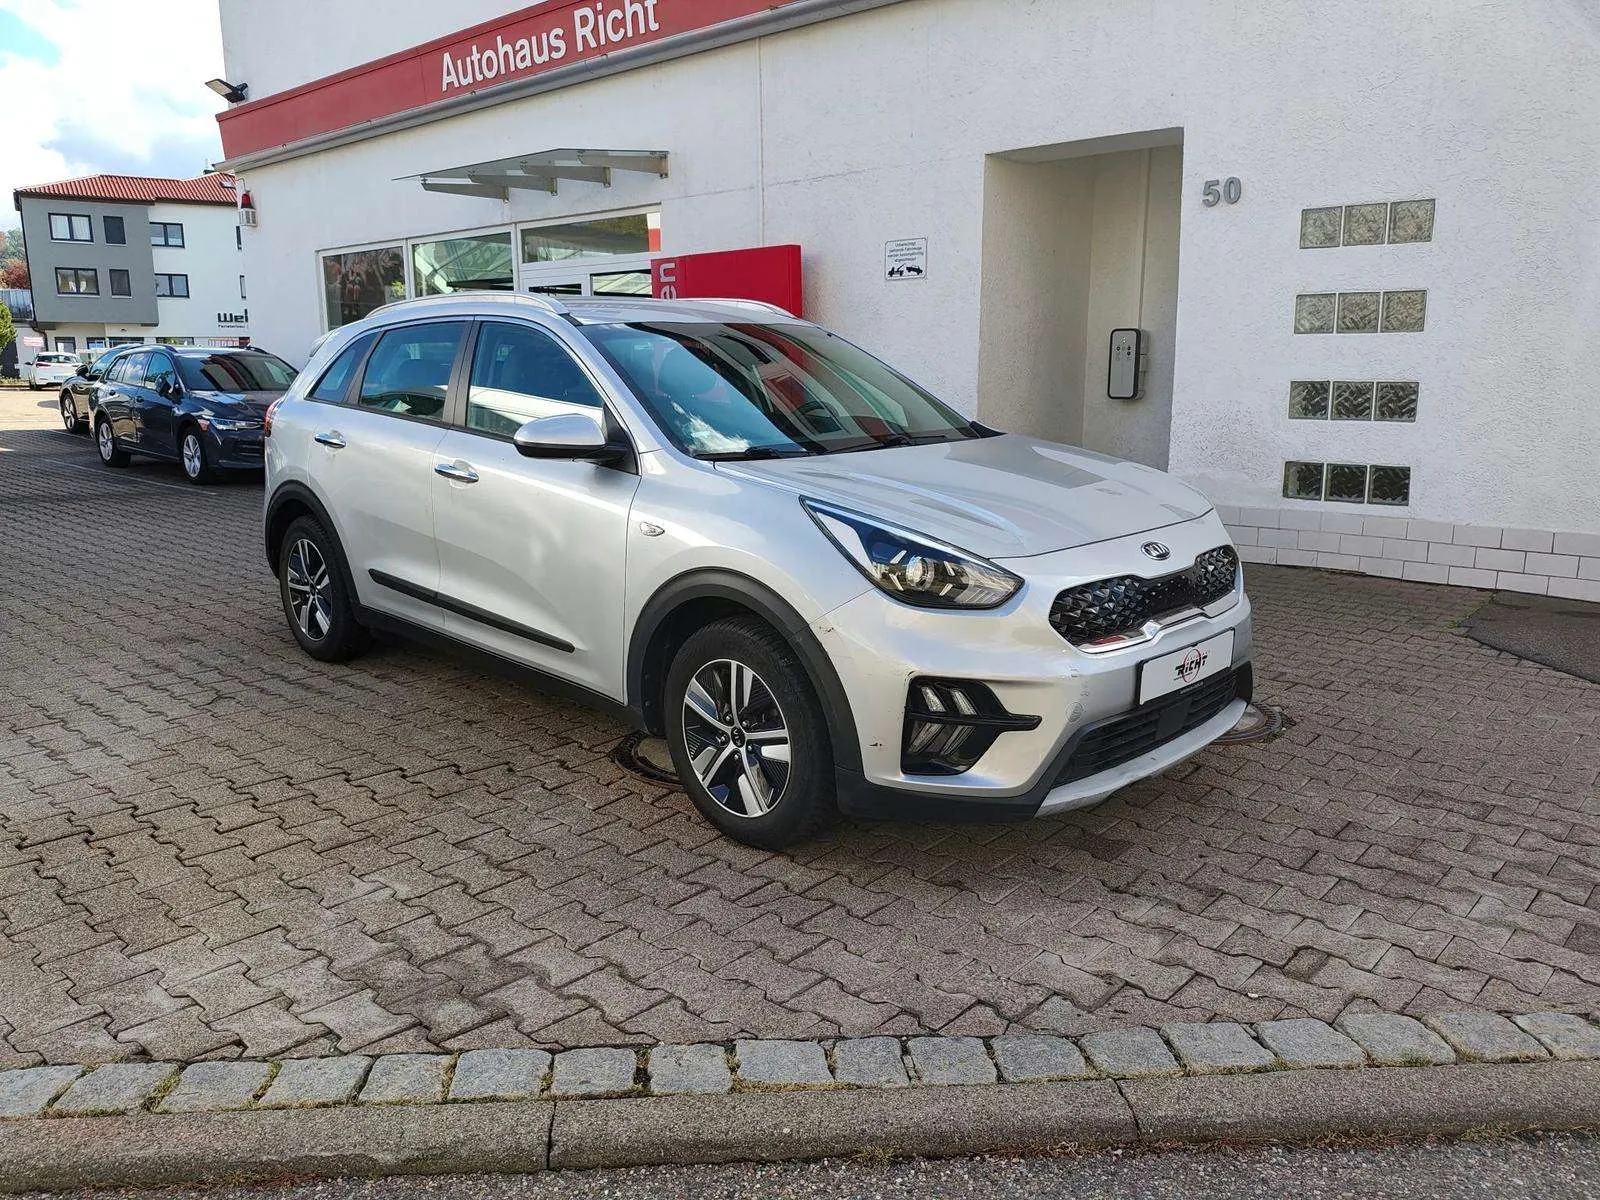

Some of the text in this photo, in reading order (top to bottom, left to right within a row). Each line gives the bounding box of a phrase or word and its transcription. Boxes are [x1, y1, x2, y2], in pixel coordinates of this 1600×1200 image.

[442, 0, 660, 92] Autohaus Richt
[1202, 176, 1242, 207] 50
